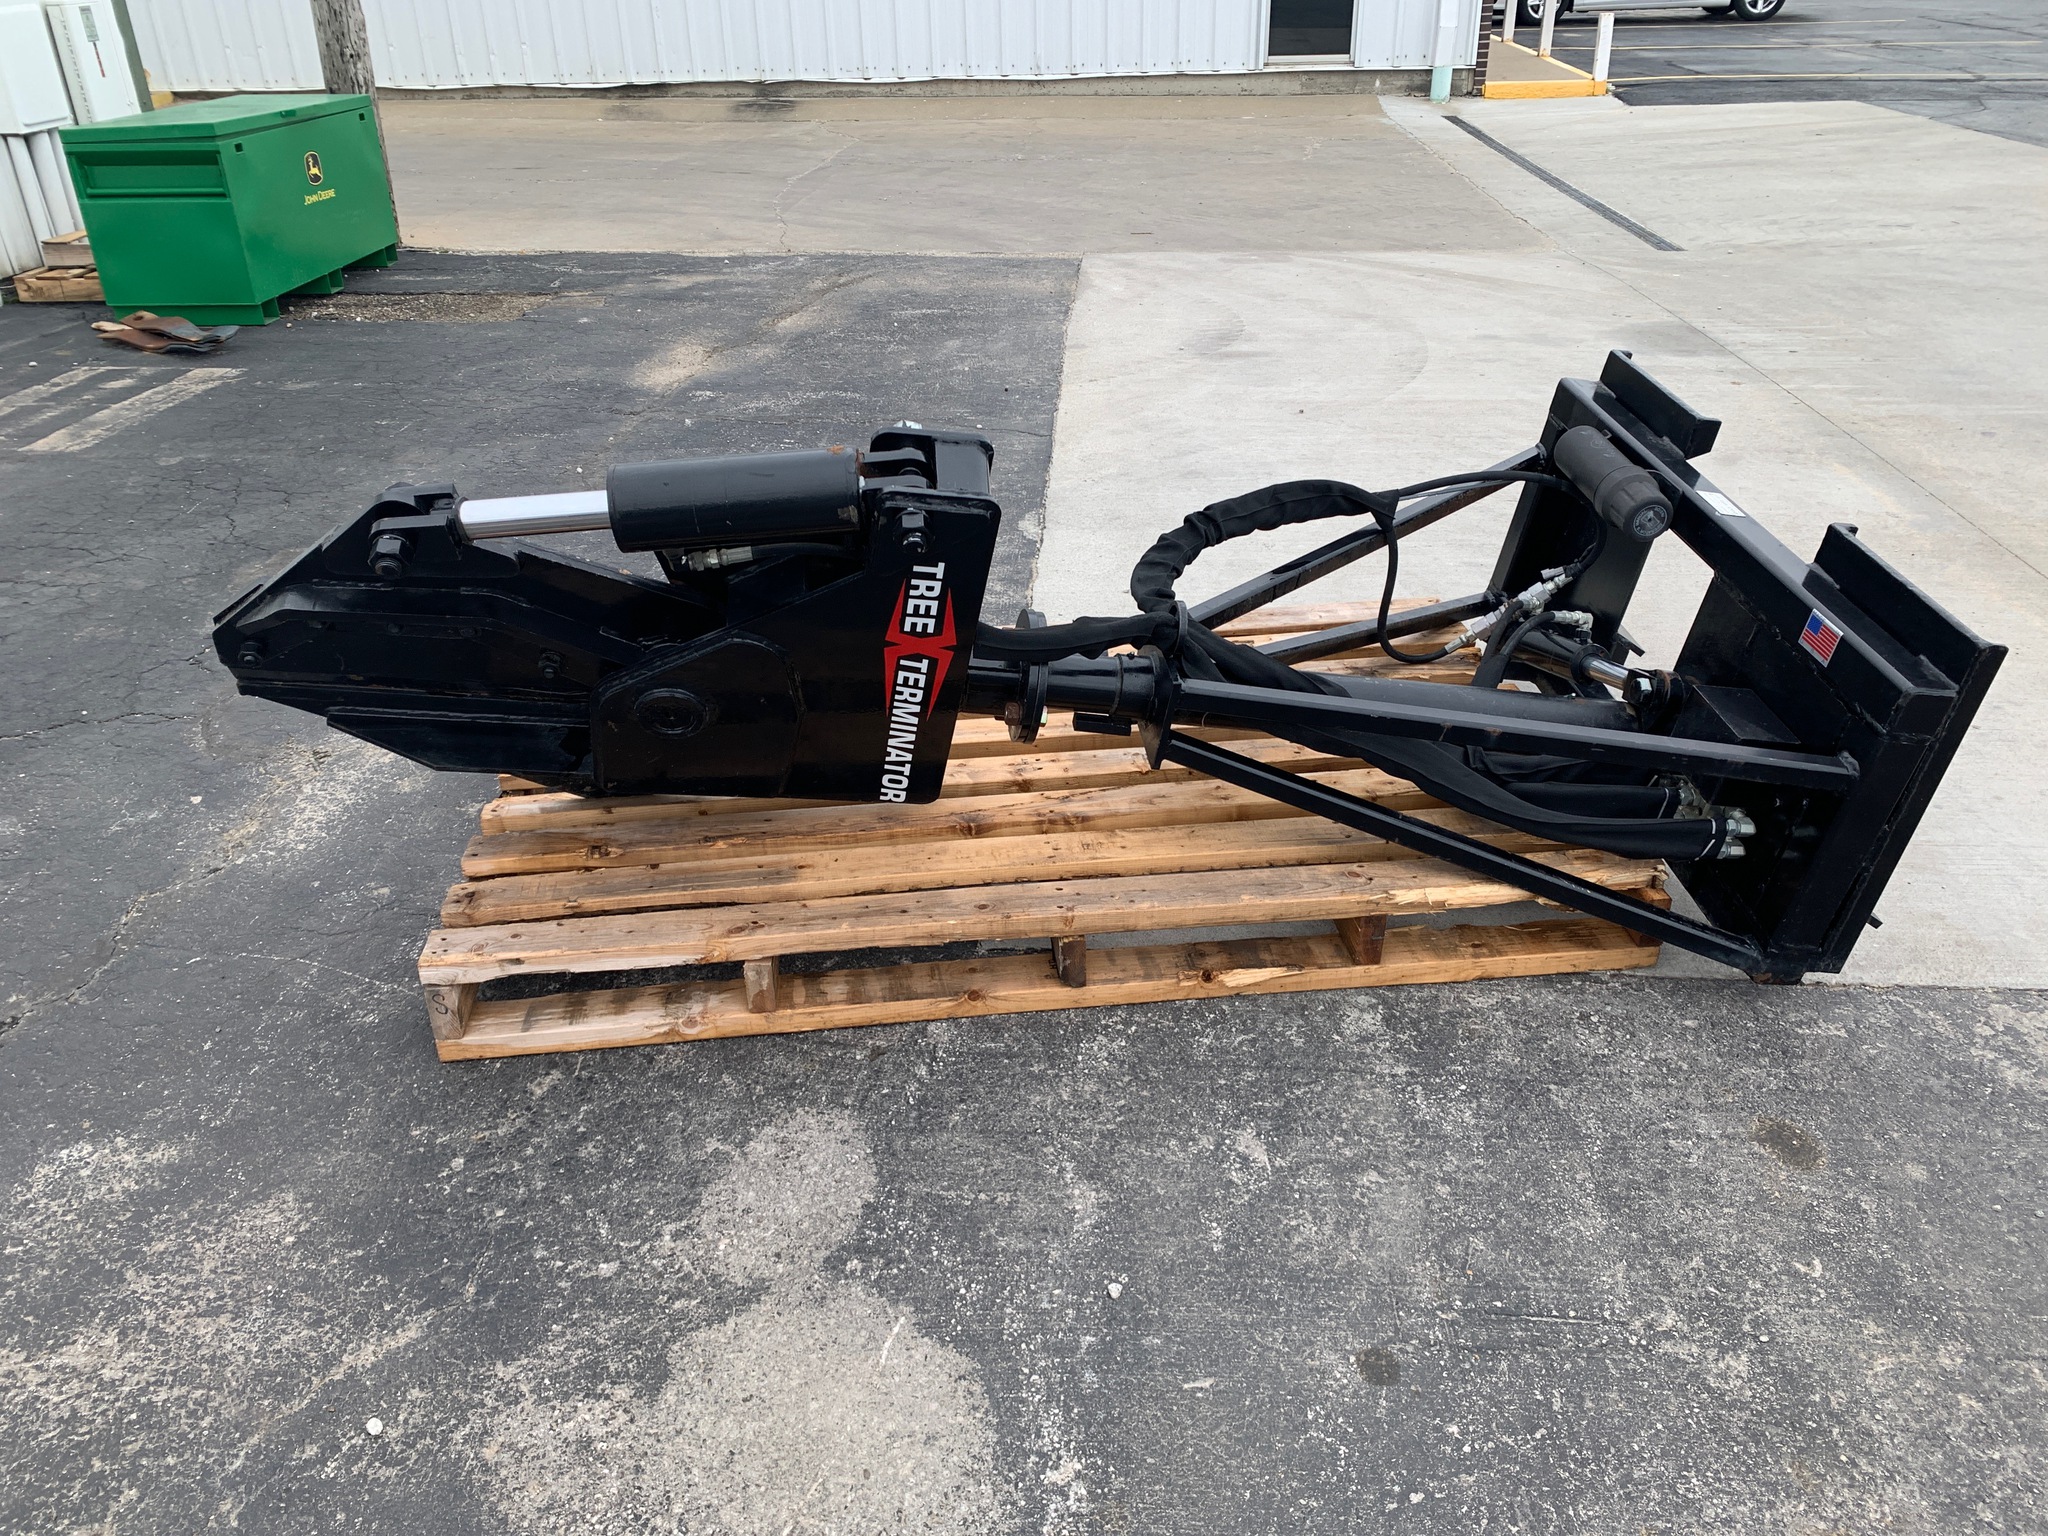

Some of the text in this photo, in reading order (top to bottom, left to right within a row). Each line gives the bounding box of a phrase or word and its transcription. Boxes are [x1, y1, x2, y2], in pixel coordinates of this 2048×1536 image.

[304, 188, 336, 205] JOHN DEERE
[903, 562, 945, 634] TREE
[432, 994, 448, 1014] S
